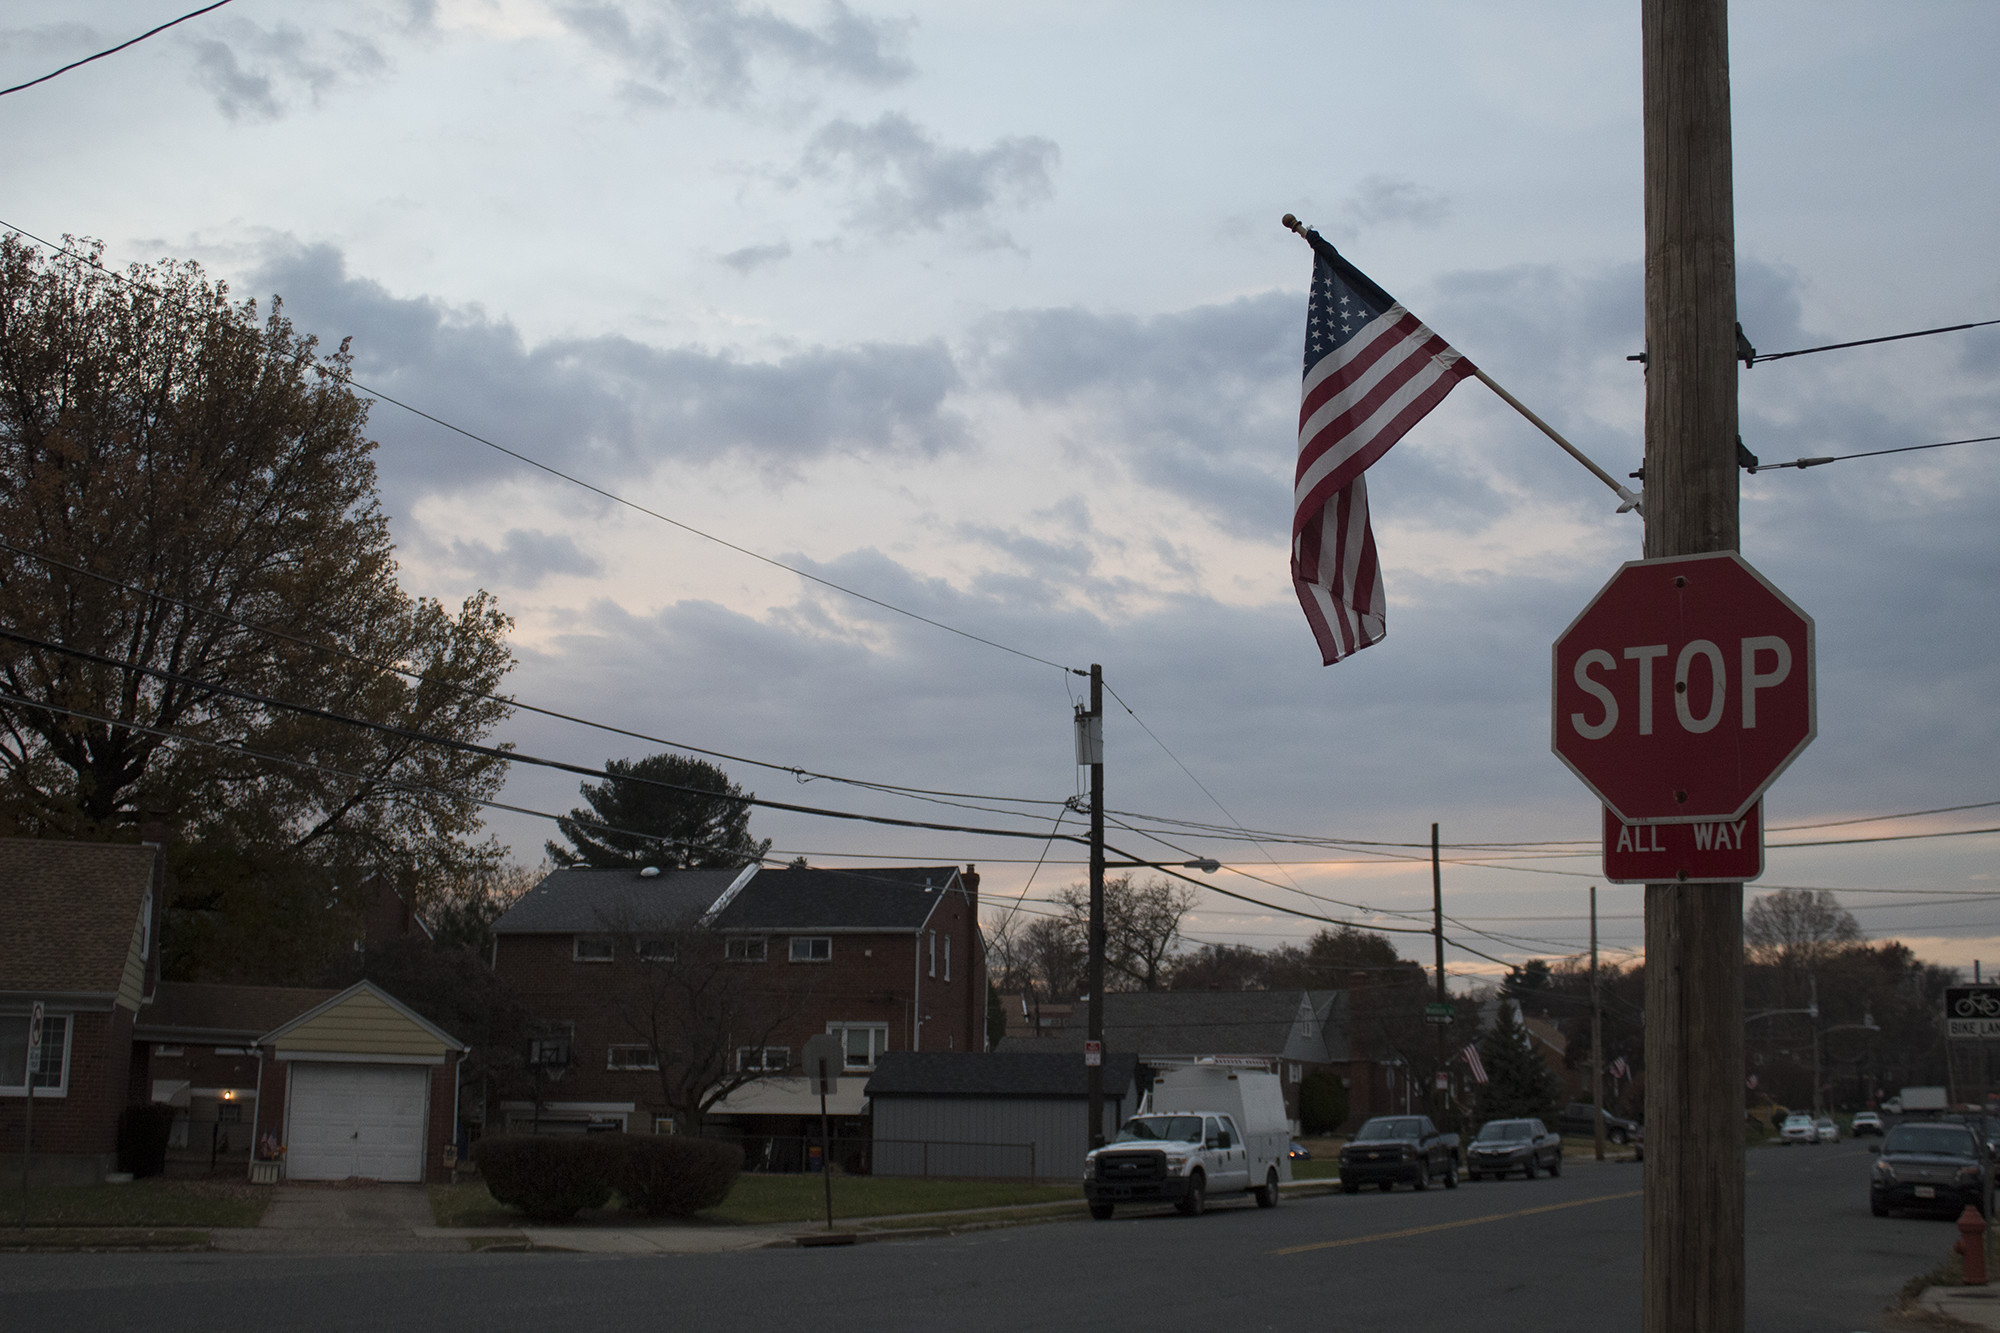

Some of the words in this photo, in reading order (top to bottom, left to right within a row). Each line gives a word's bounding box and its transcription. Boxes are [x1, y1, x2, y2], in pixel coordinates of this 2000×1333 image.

[1571, 635, 1792, 740] STOP
[1616, 824, 1666, 853] ALL
[1693, 820, 1747, 851] WAY
[1951, 1021, 1976, 1034] BIKE
